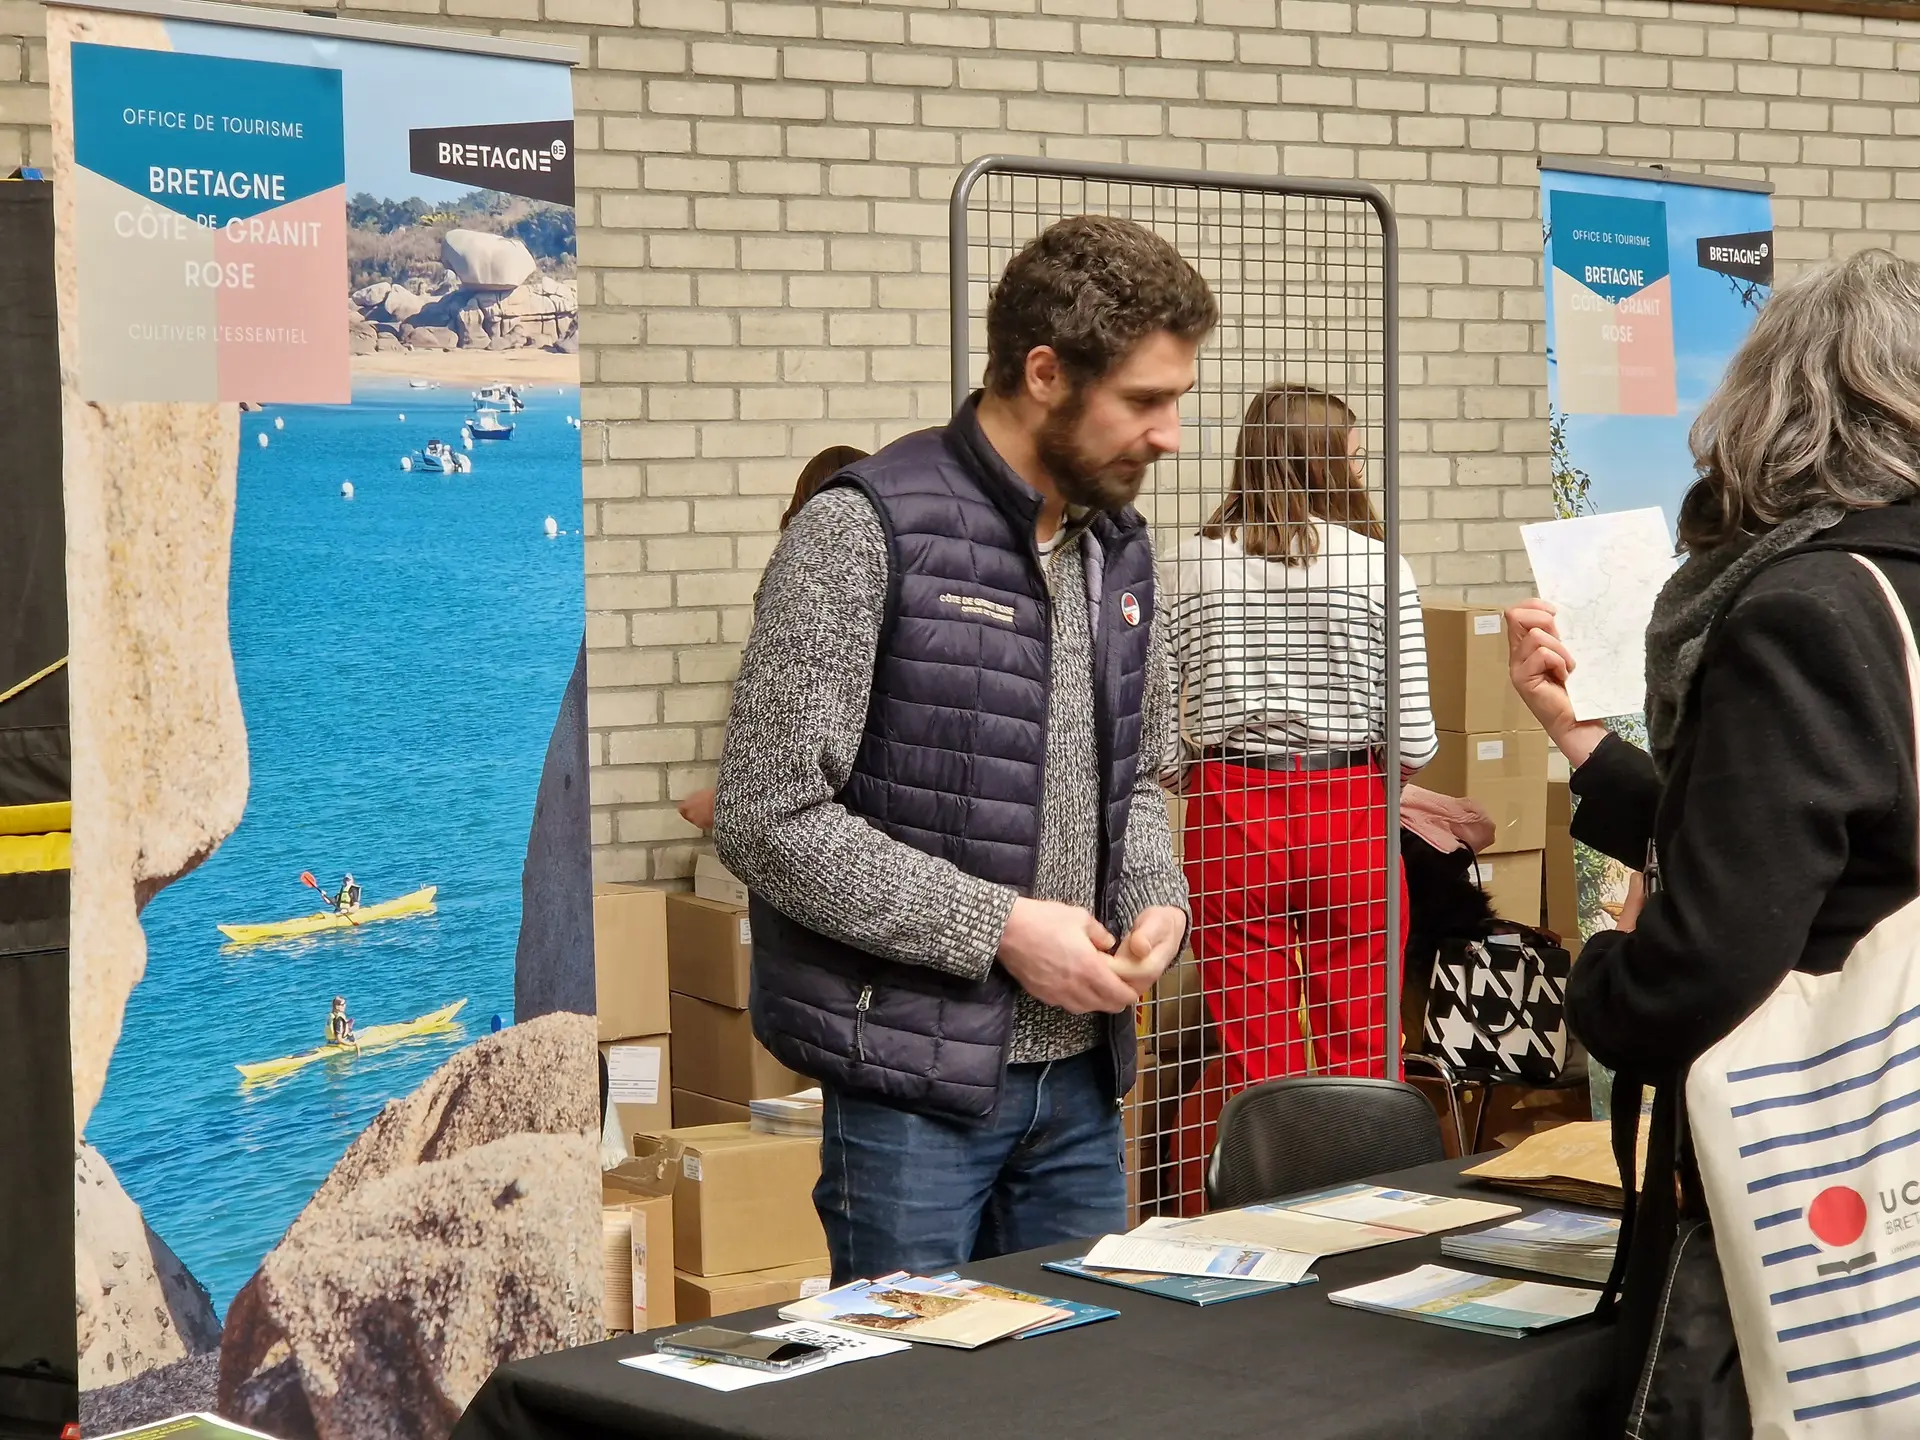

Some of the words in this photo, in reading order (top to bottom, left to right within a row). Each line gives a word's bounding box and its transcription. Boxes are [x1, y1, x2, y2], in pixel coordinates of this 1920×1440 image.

[123, 107, 187, 130] OFFICE
[193, 112, 215, 132] DE
[221, 116, 304, 139] TOURISME
[438, 141, 552, 173] BRETAGNE
[149, 166, 285, 201] BRETAGNE
[114, 206, 187, 242] CÔTE
[196, 213, 217, 231] DE
[226, 218, 321, 248] GRANIT
[1573, 229, 1600, 242] OFFICE
[1602, 232, 1612, 243] DE
[1615, 233, 1650, 247] TOURISME
[1710, 246, 1760, 265] BRETAGNE
[185, 261, 256, 289] ROSE
[1585, 266, 1644, 286] BRETAGNE
[1571, 291, 1604, 313] CÔTE
[1606, 295, 1616, 305] DE
[1619, 297, 1660, 316] GRANIT
[128, 324, 207, 343] CULTIVER
[213, 325, 308, 344] L'ESSENTIEL
[1601, 325, 1634, 343] ROSE
[565, 1309, 578, 1348] aint
